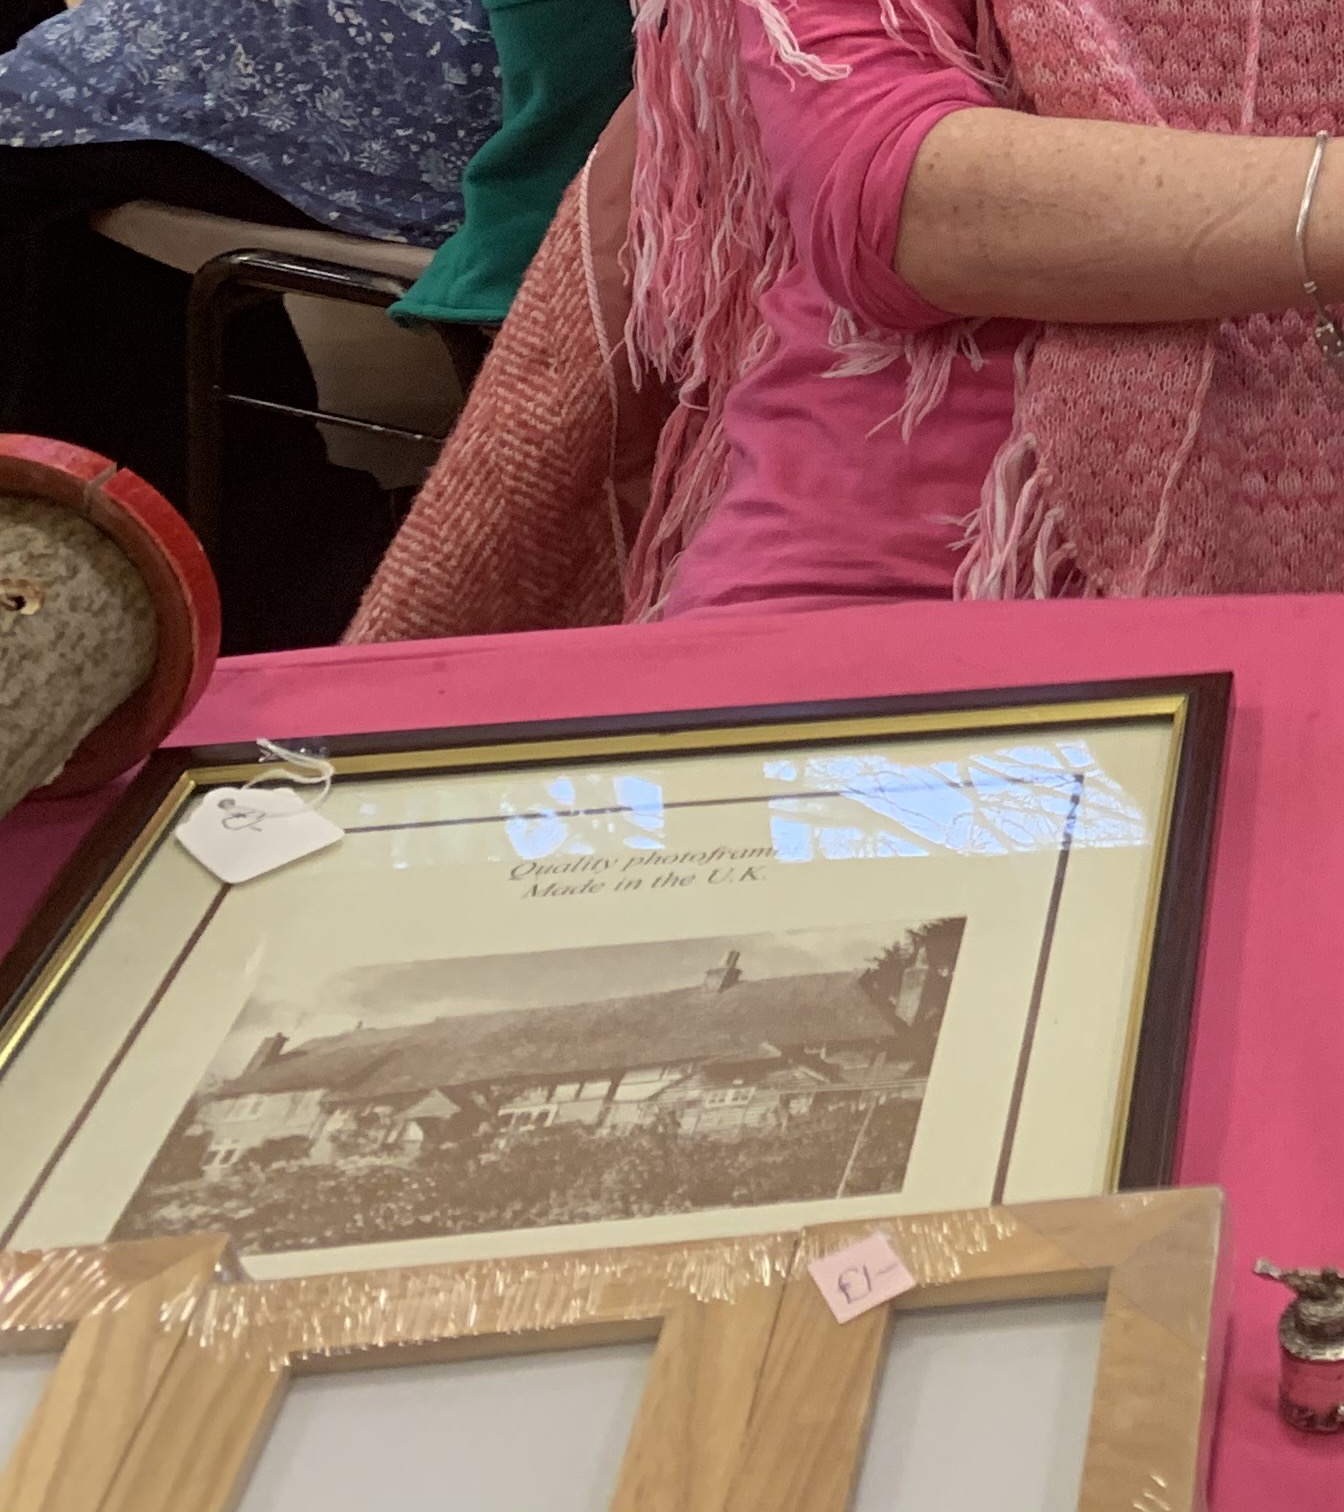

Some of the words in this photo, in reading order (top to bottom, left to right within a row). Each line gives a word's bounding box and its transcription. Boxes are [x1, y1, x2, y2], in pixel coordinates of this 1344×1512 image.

[507, 854, 618, 882] Quality
[519, 878, 606, 900] Made
[613, 877, 643, 892] in
[650, 871, 697, 890] the
[706, 865, 768, 886] U.K.
